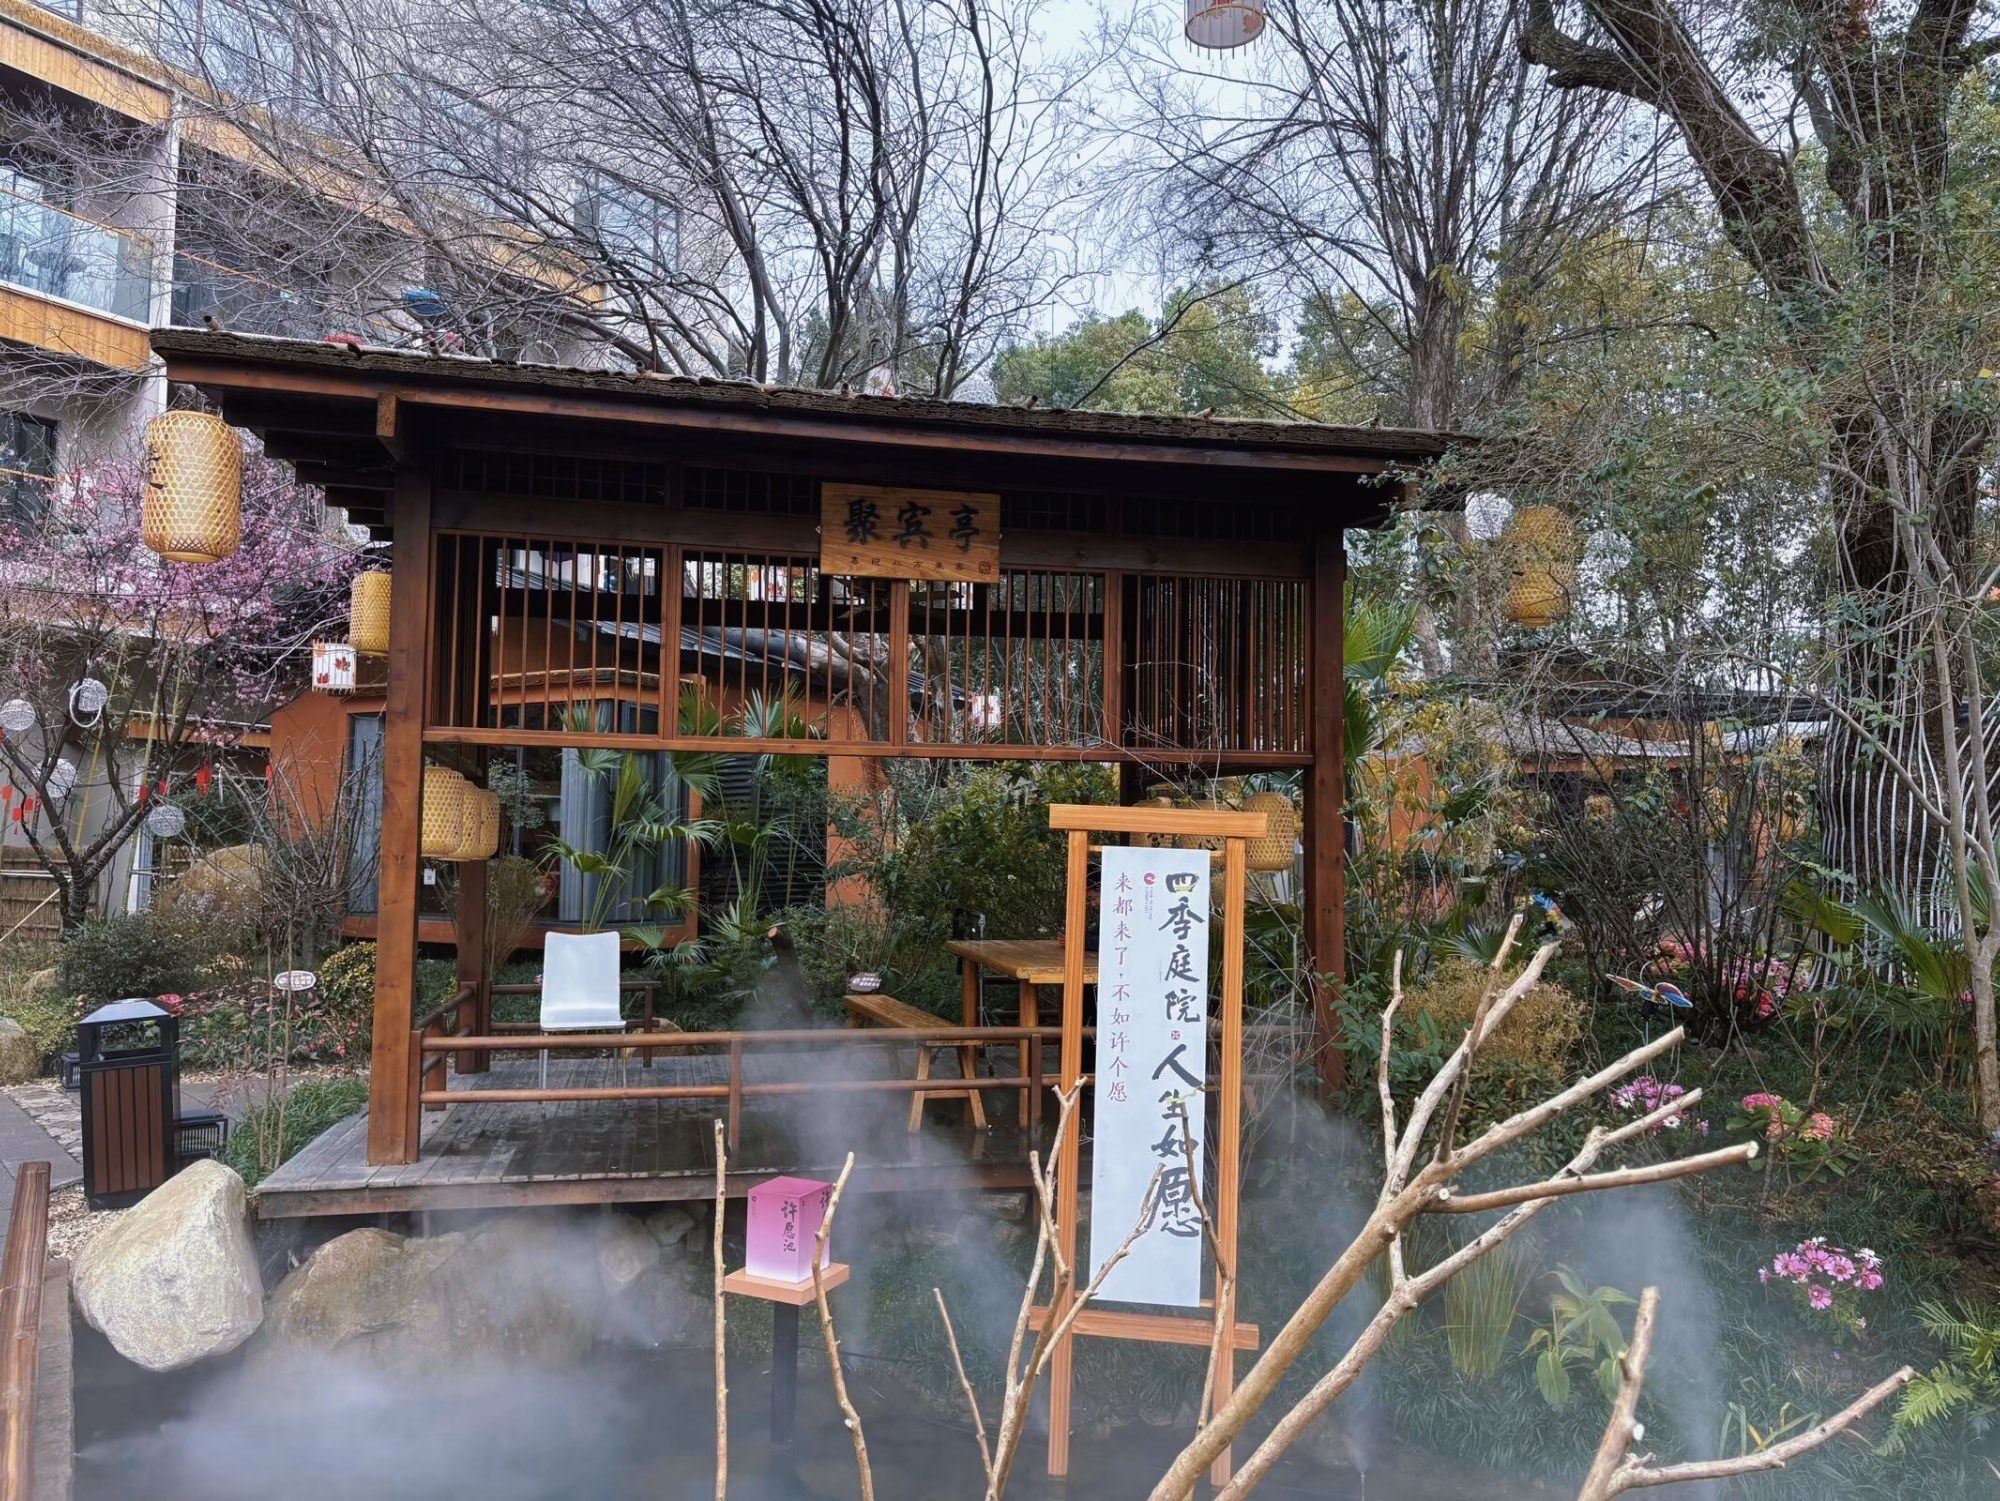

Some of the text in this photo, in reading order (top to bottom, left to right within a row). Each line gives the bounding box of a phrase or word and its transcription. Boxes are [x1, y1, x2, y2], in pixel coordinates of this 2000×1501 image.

[1147, 872, 1205, 1238] 四季庭院 人生如愿
